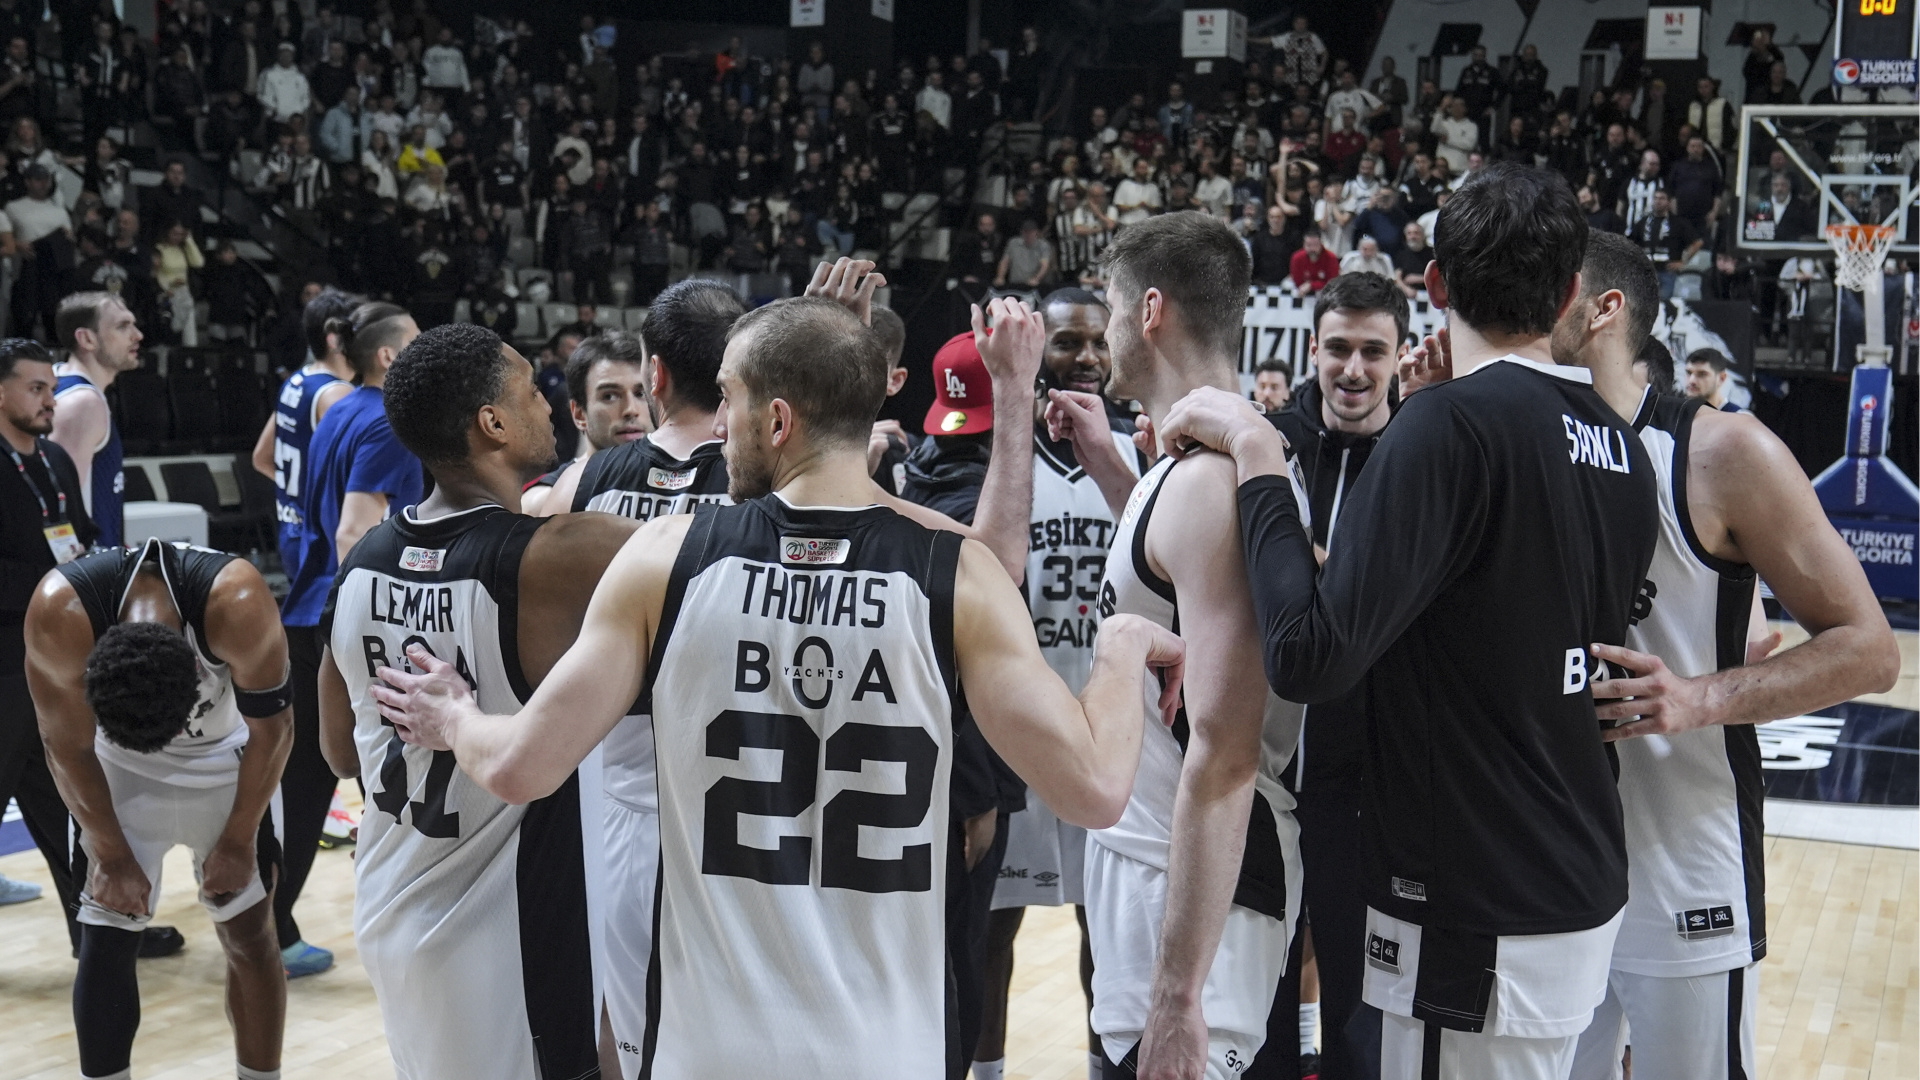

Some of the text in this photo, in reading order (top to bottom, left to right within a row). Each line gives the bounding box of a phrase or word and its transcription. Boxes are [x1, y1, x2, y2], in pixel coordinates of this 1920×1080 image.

[944, 368, 966, 398] LA
[1029, 511, 1119, 552] EŞİKT
[1852, 544, 1914, 566] GORTA
[742, 563, 889, 629] THOMAS
[1042, 555, 1107, 602] 33
[371, 577, 455, 633] LEMAR
[734, 636, 898, 710] BOA
[784, 666, 844, 679] YACHTS
[702, 709, 938, 892] 22
